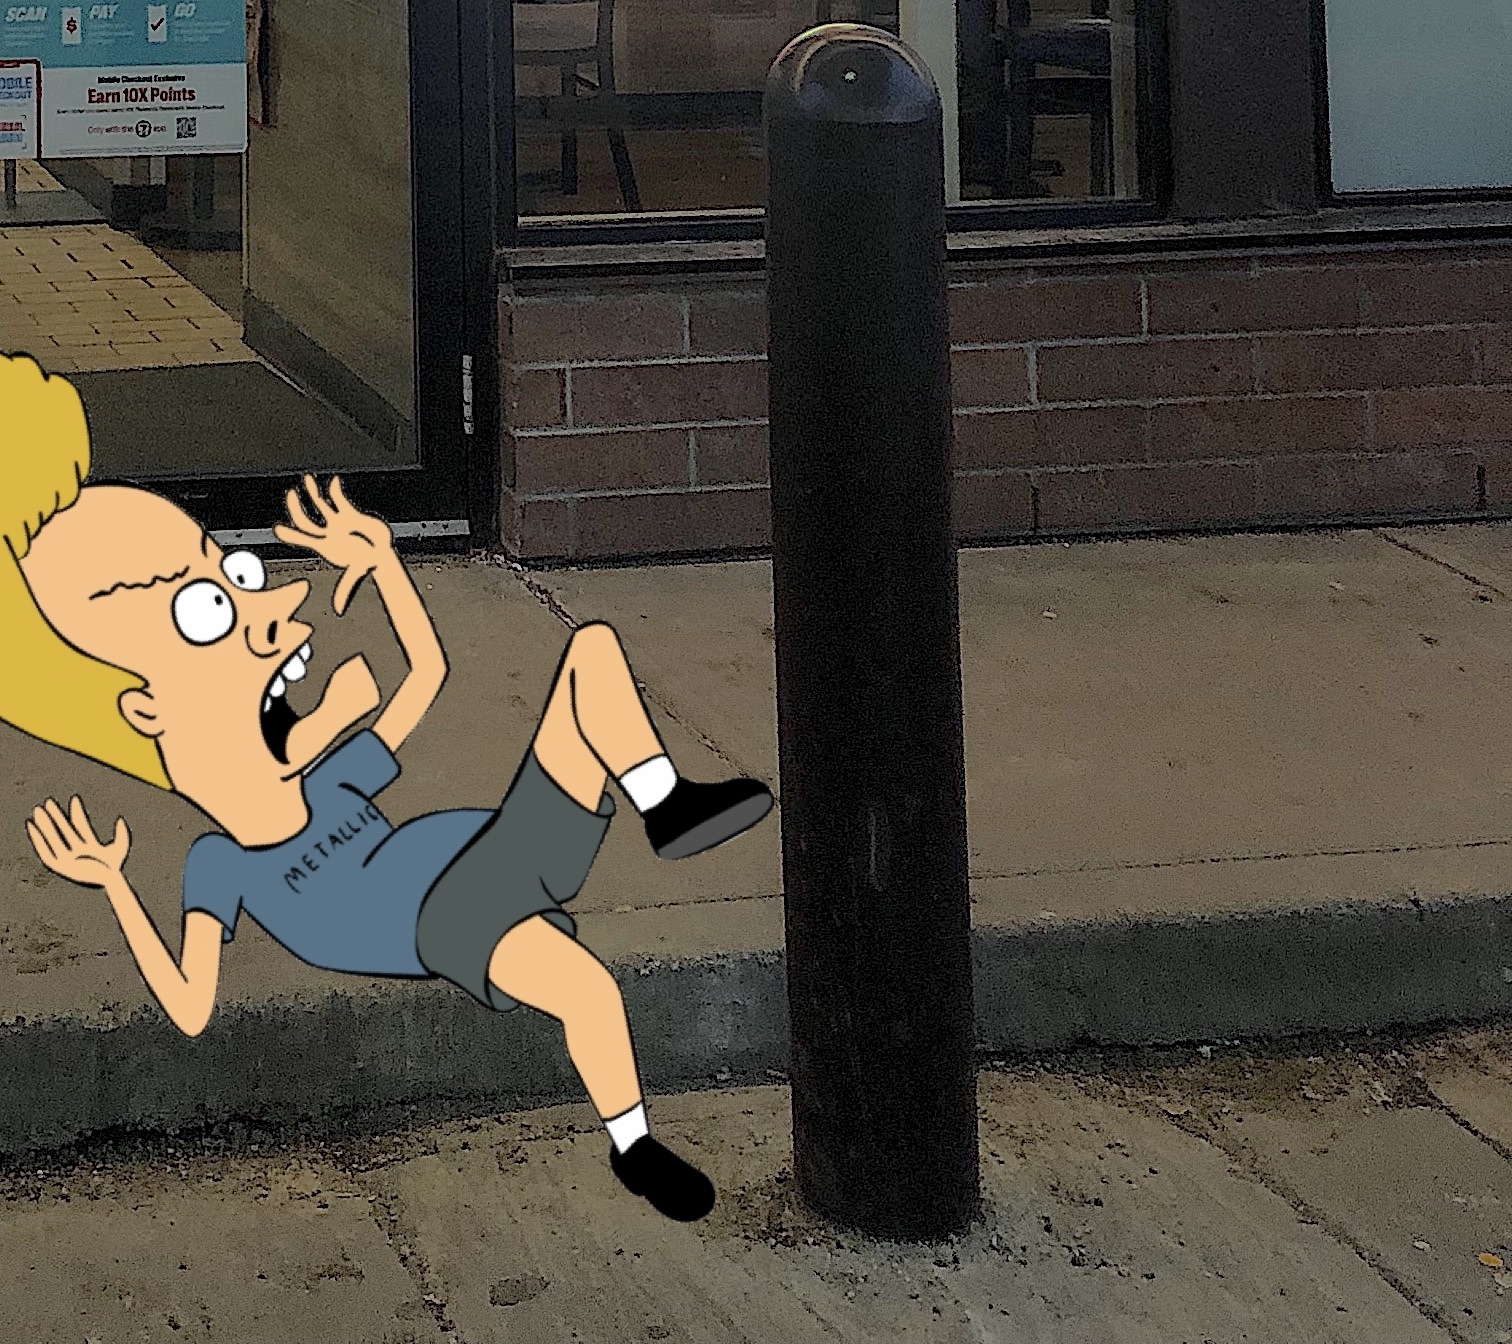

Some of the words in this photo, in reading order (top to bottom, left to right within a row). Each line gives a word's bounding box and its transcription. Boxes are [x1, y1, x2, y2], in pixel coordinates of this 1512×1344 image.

[5, 6, 48, 22] SCAN
[89, 3, 120, 19] PAY
[173, 1, 197, 18] GO
[121, 75, 153, 84] Checkout
[88, 87, 121, 104] Earn
[123, 87, 149, 103] 10X
[150, 86, 196, 102] Points
